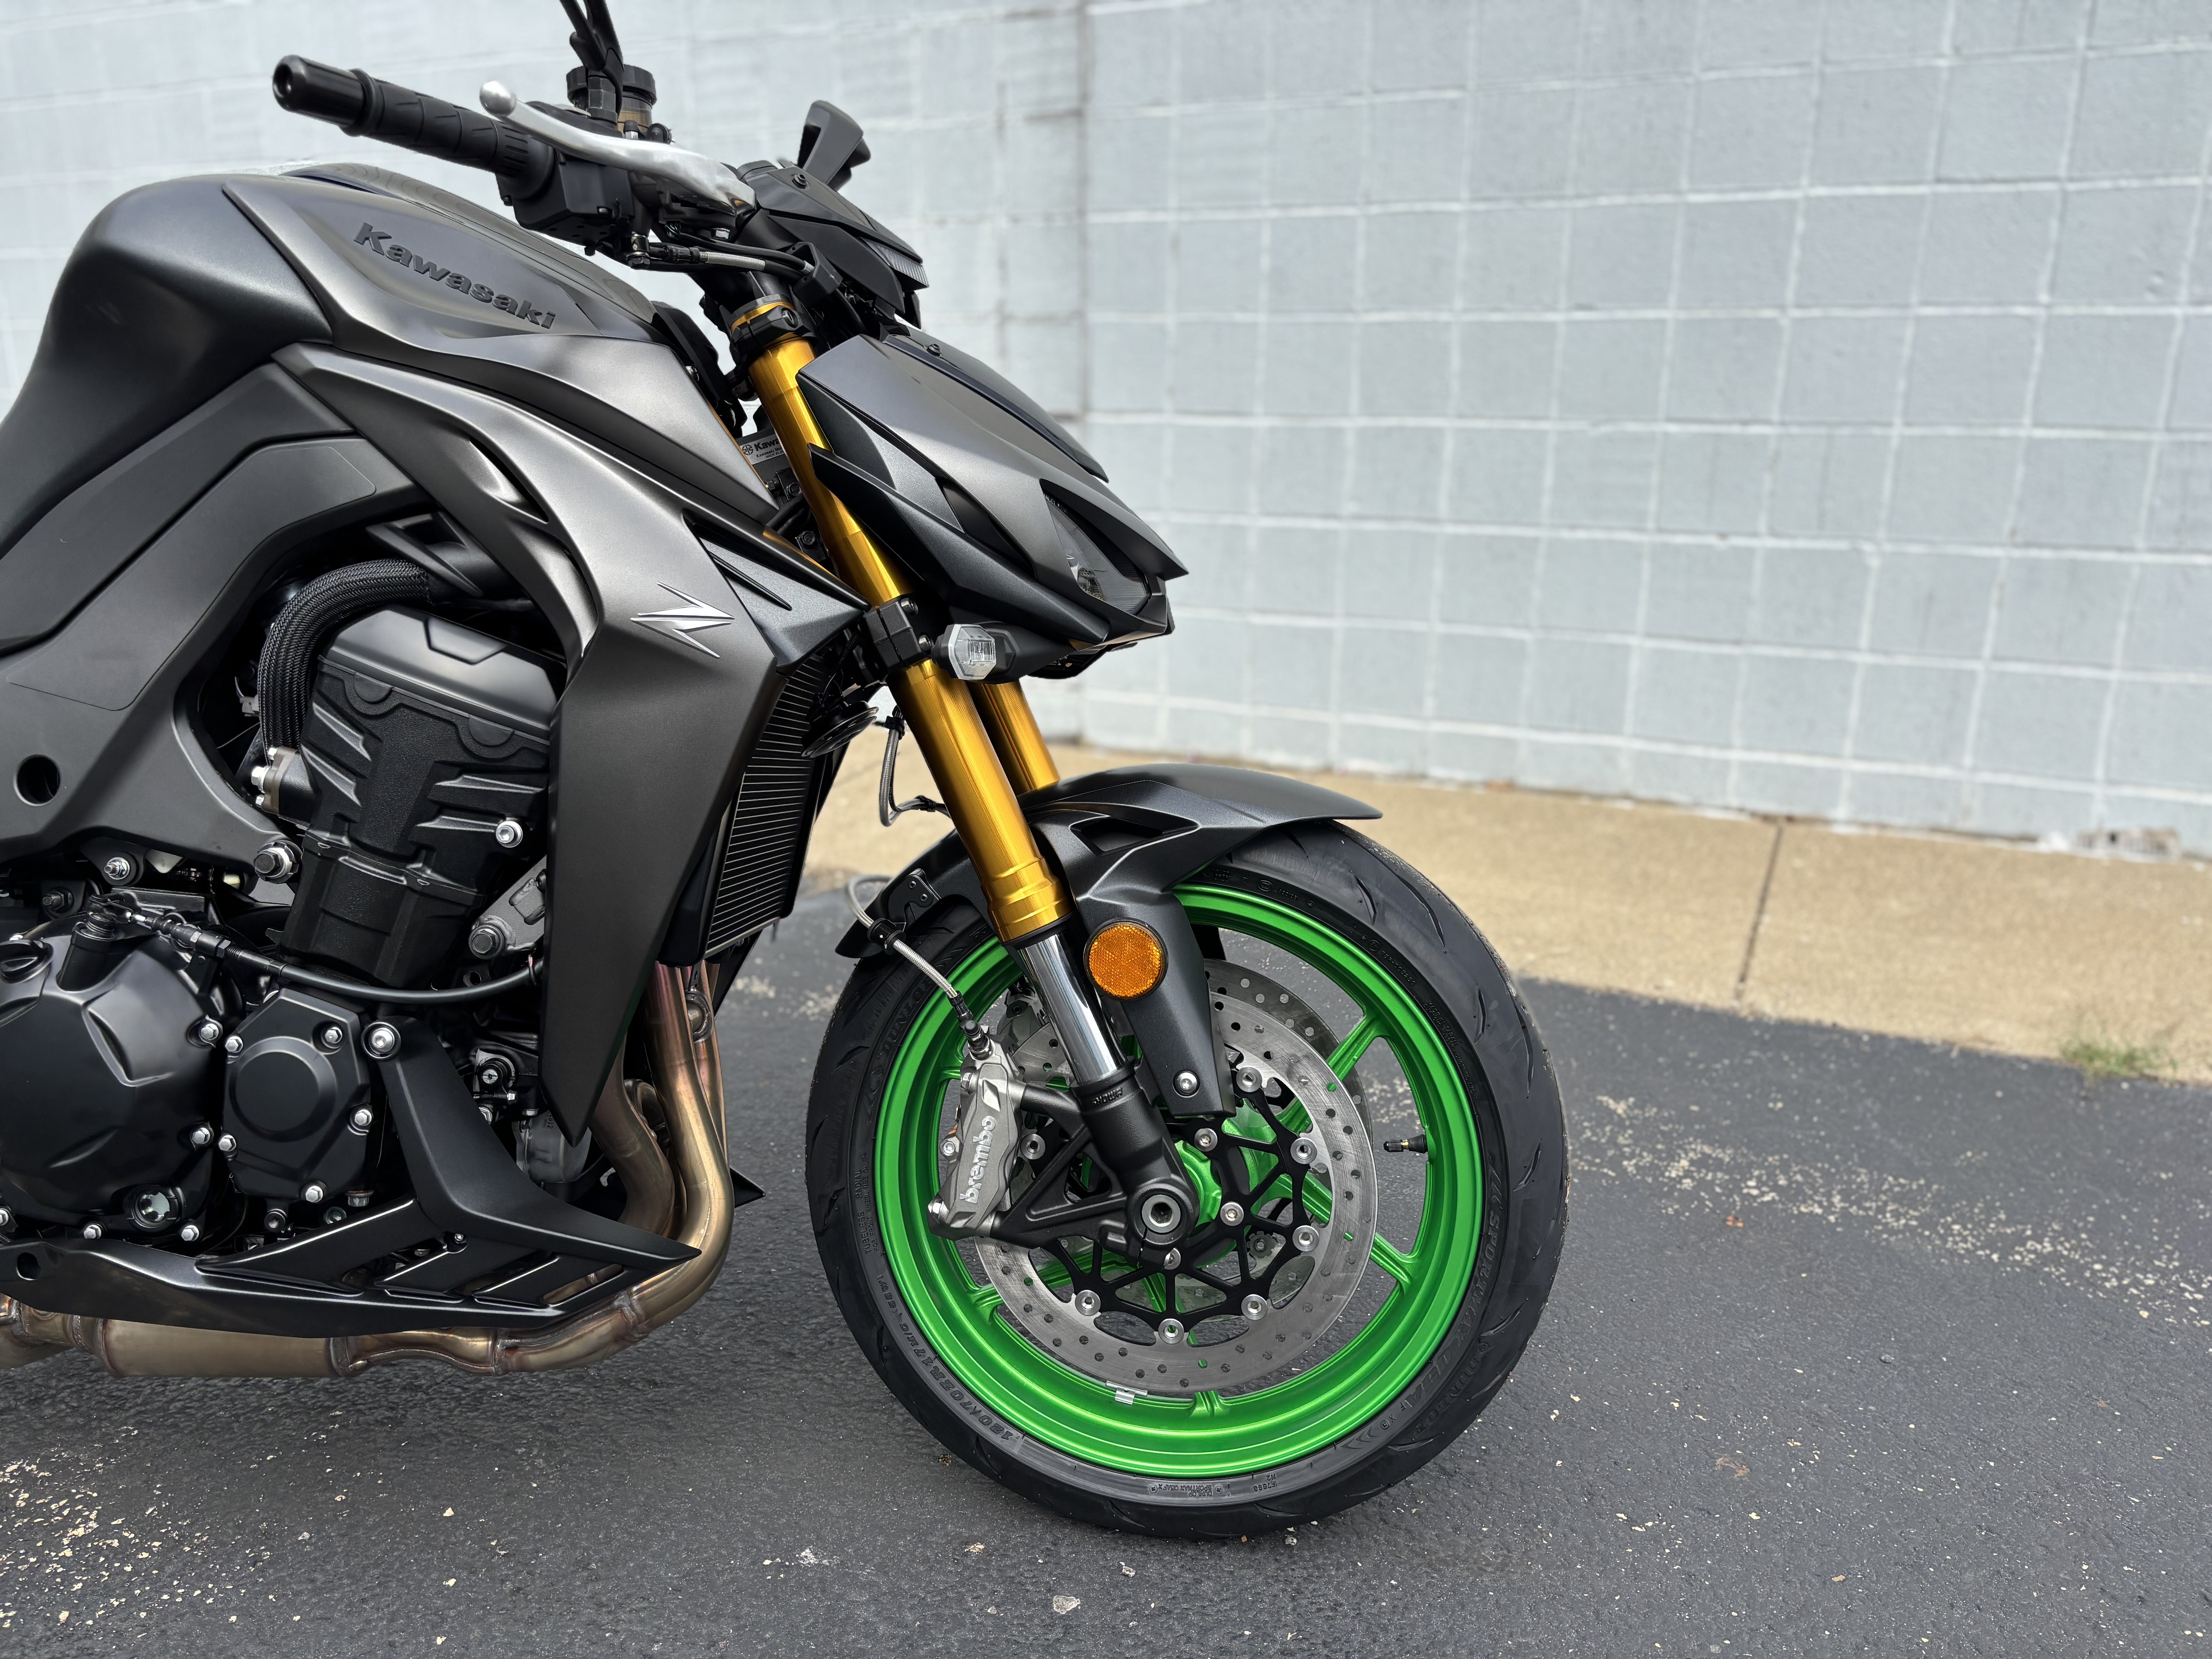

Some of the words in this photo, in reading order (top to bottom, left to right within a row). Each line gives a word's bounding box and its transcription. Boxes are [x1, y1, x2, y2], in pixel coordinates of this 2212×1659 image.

[354, 222, 556, 330] Kawasaki
[854, 1169, 863, 1199] RADIAL
[959, 1116, 996, 1204] brembo
[858, 1211, 872, 1254] TUBELESS
[1454, 1211, 1500, 1343] SPORTMAX
[1413, 1357, 1480, 1437] DUNLOP
